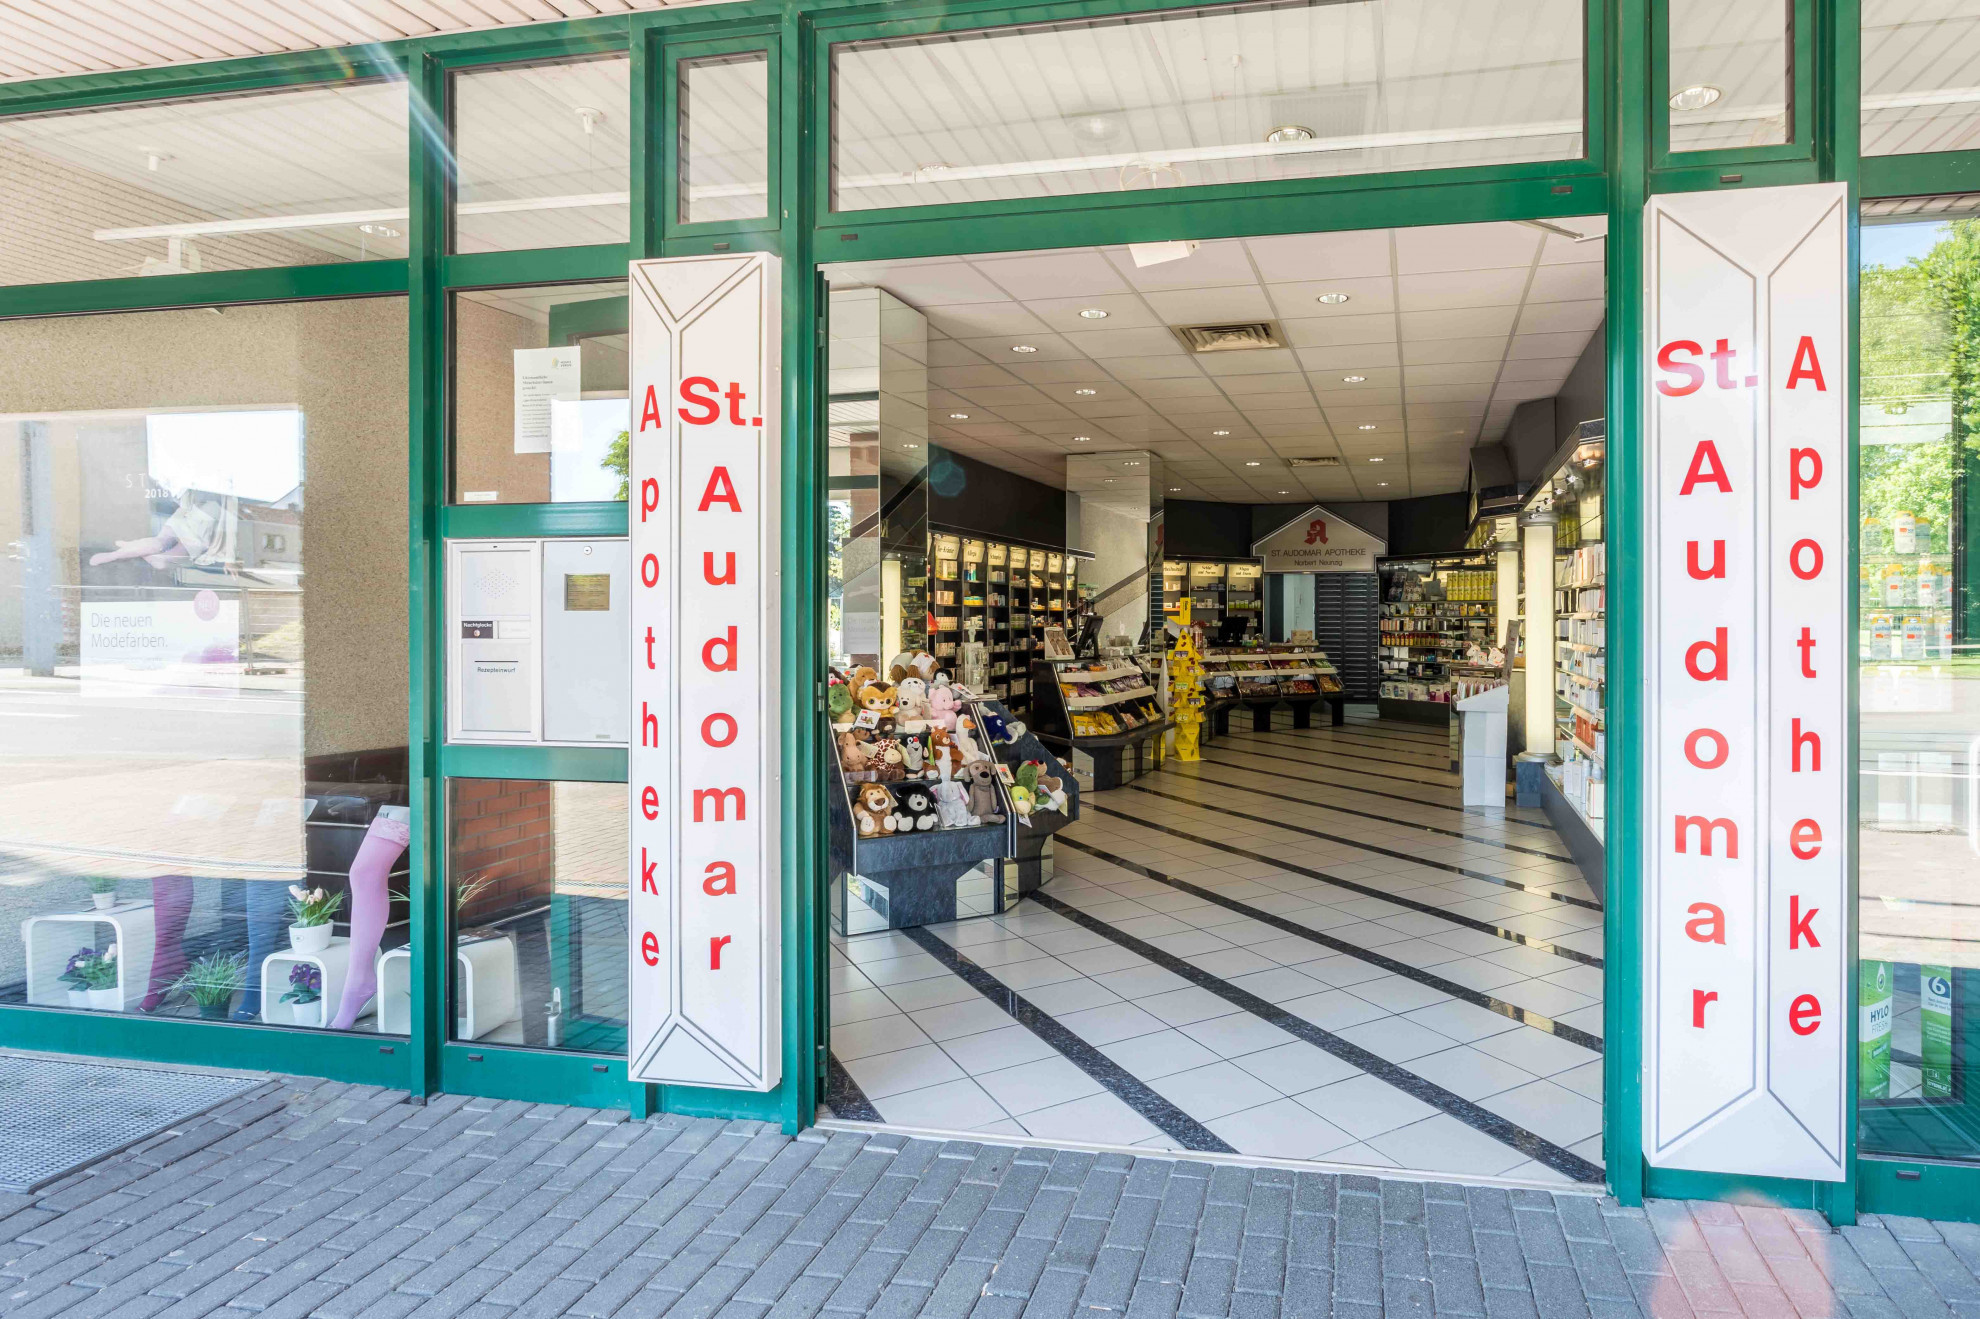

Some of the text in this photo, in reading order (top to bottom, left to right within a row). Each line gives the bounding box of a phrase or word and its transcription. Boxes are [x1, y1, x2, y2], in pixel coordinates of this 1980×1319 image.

[1656, 338, 1758, 397] St.
[677, 375, 763, 427] St.
[144, 488, 169, 500] 2018
[1283, 548, 1322, 557] AUDOMAR
[1325, 548, 1366, 556] APOTHEKE
[91, 612, 153, 628] Die neuen
[91, 632, 169, 648] Modefarben.
[477, 666, 516, 674] Rezepteinwurf
[639, 384, 662, 968] Apotheke
[1785, 335, 1827, 1036] Apotheke
[693, 465, 746, 972] Audomar
[1674, 439, 1739, 1029] Audomar
[1870, 1004, 1889, 1023] HYLO
